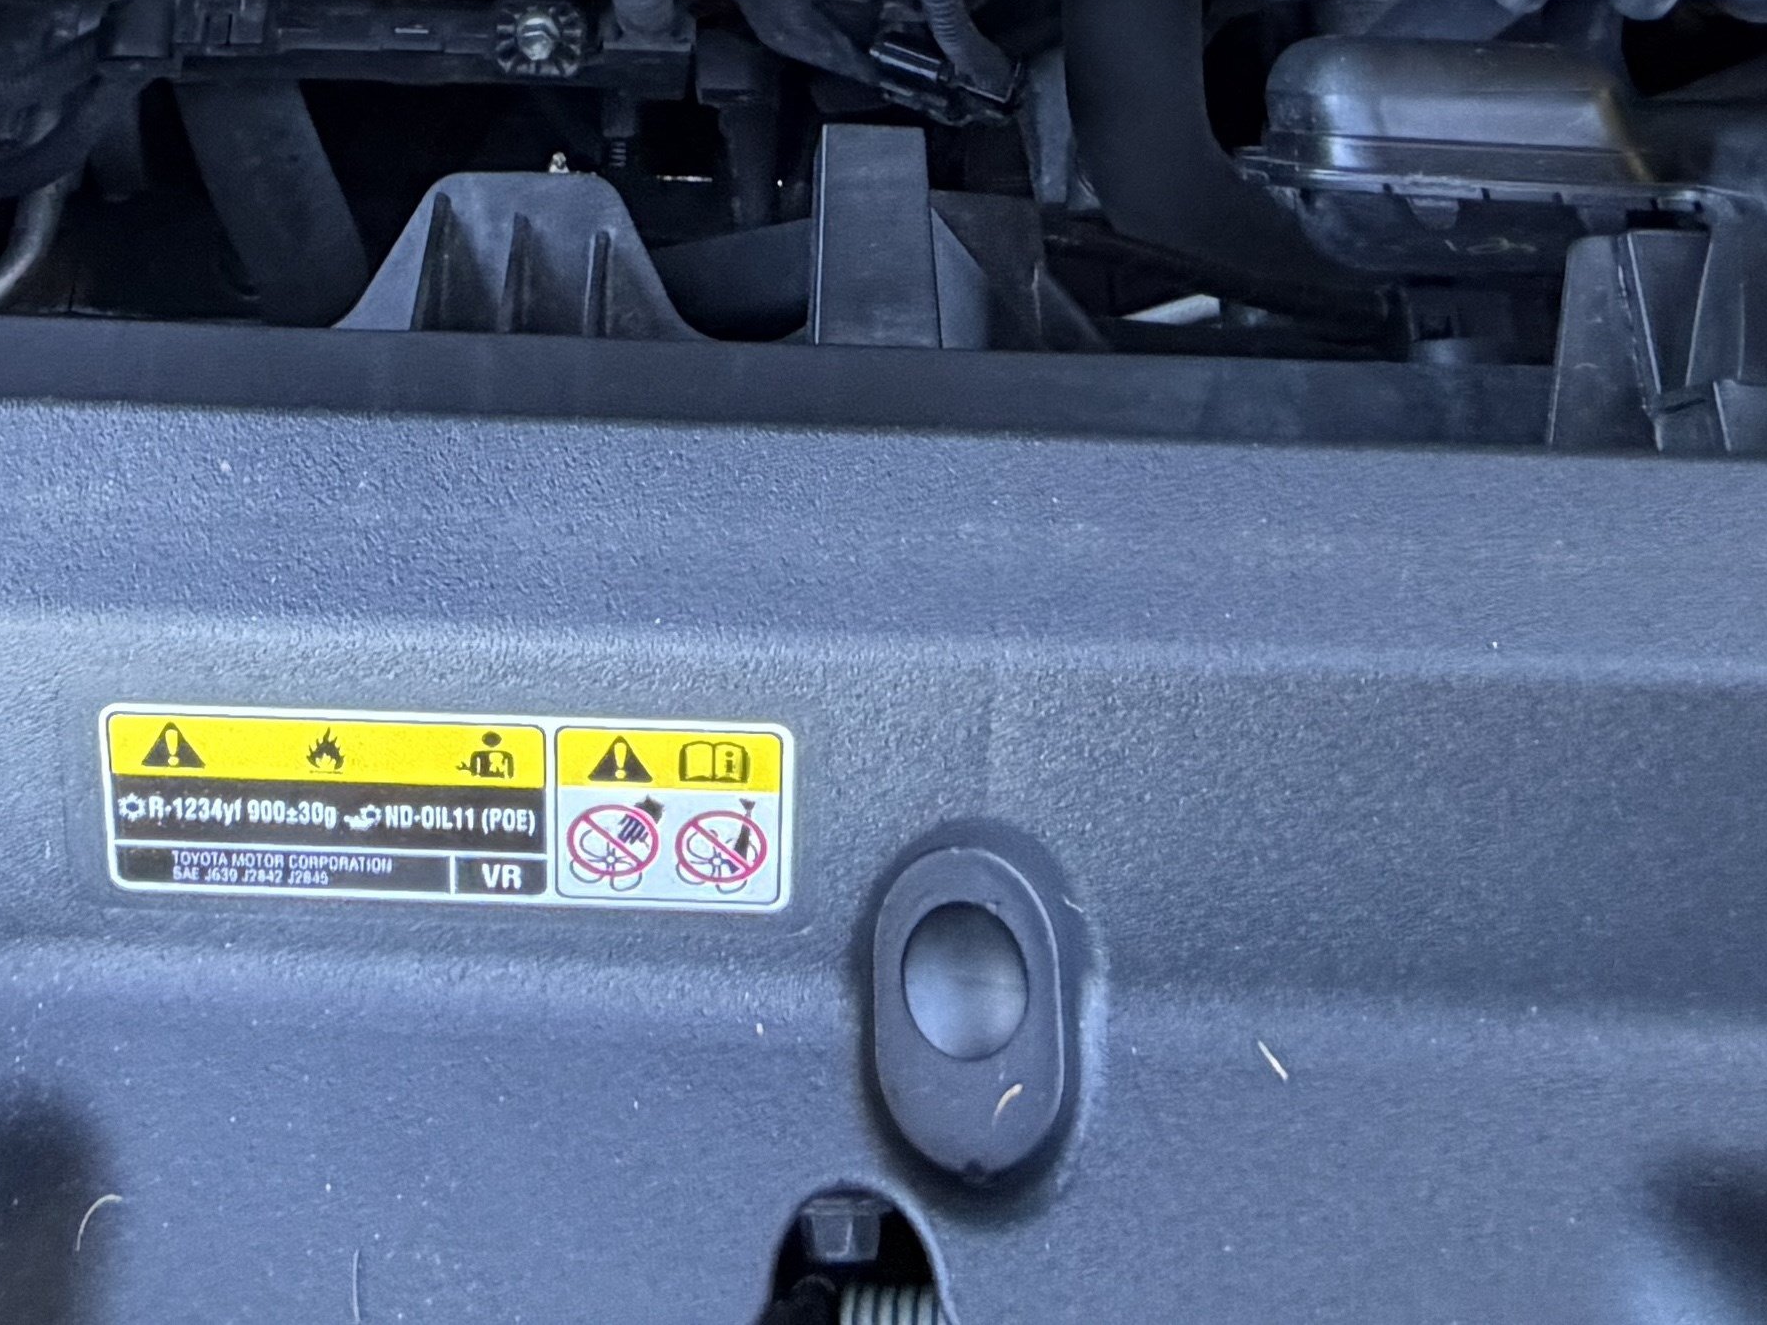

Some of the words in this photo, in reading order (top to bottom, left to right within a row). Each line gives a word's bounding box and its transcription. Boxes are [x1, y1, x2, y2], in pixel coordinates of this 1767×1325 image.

[148, 795, 242, 827] R-1234yf
[247, 798, 338, 831] 900±30g
[385, 805, 474, 832] ND-OIL11
[481, 807, 536, 837] (POE)
[172, 850, 228, 867] TOYOTA
[232, 852, 285, 869] MOTOR
[288, 853, 393, 874] CORPORATION
[481, 862, 522, 890] VR
